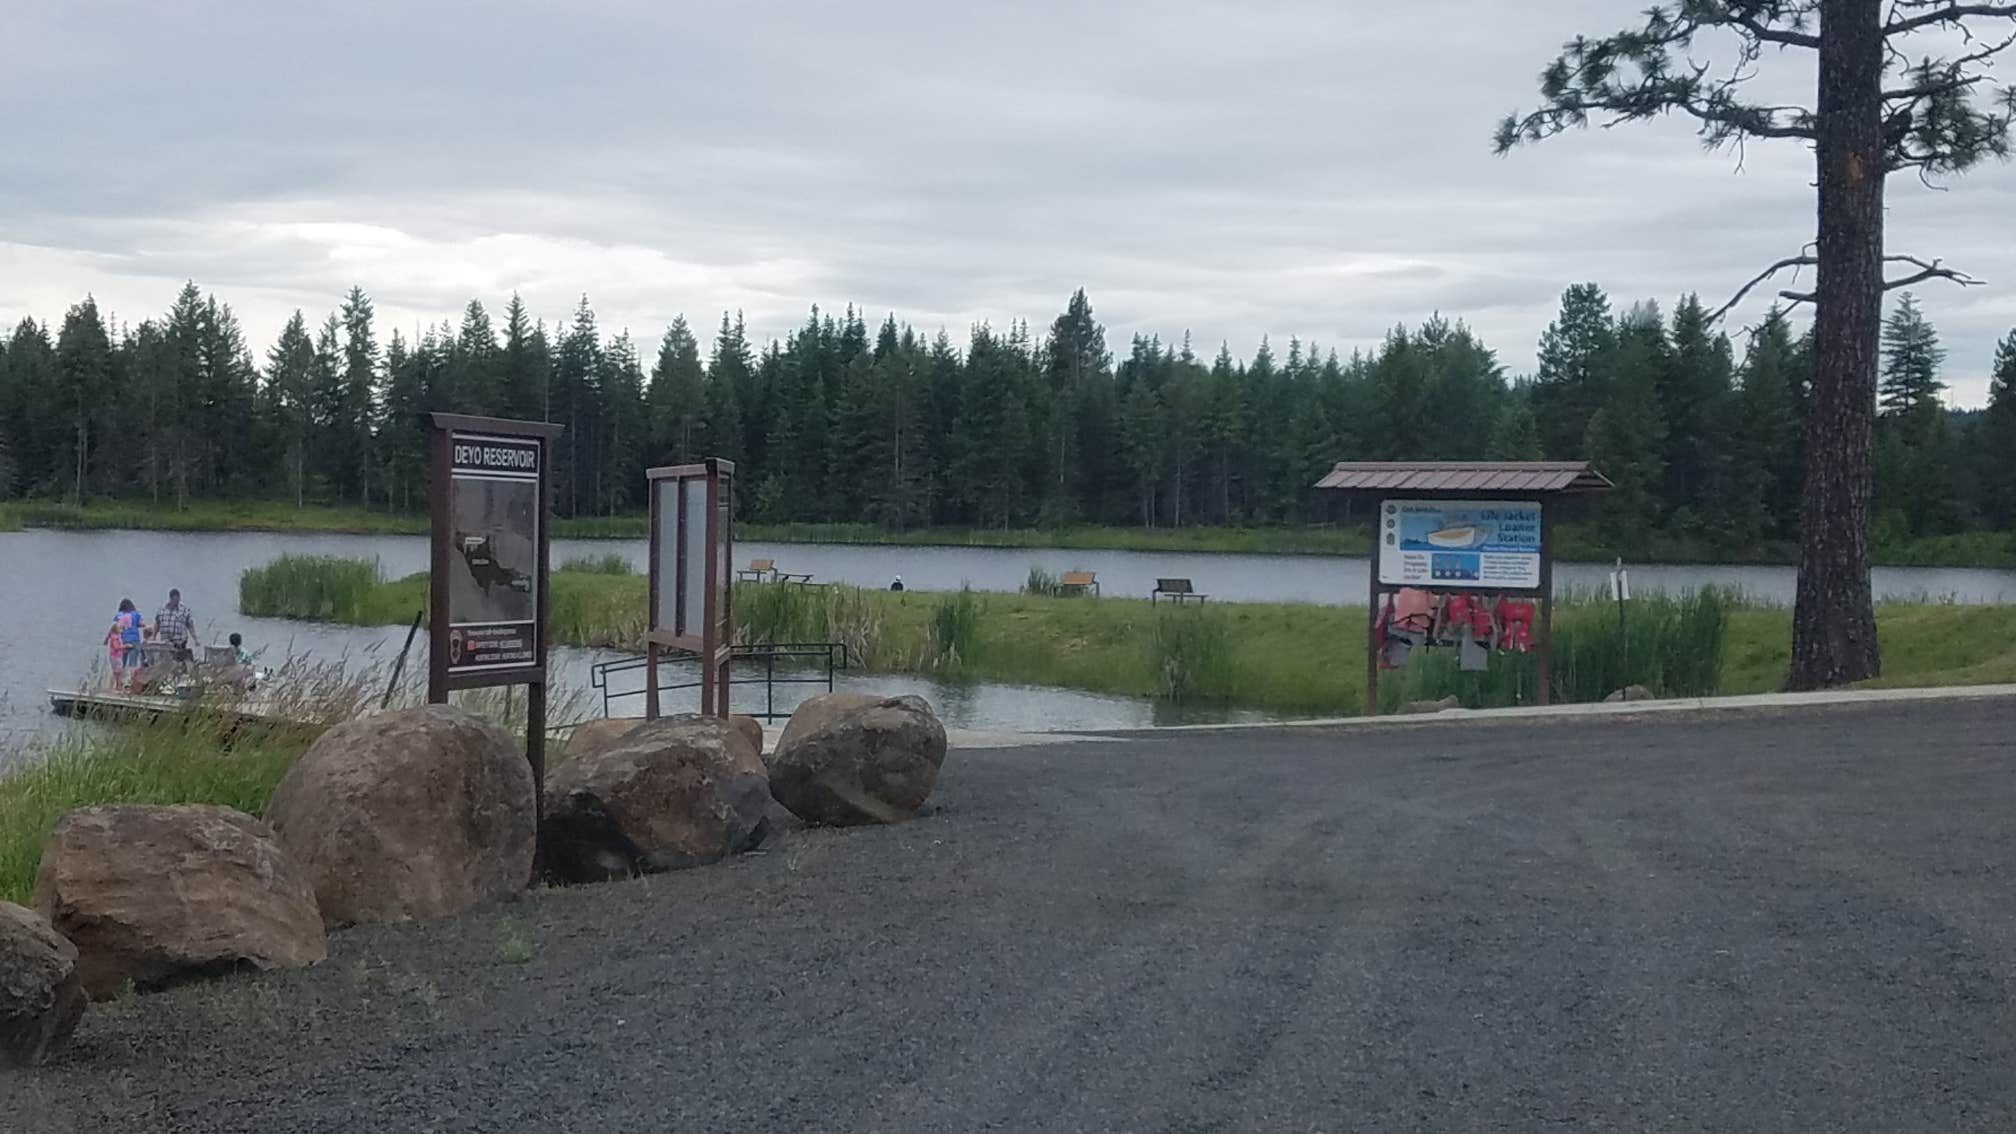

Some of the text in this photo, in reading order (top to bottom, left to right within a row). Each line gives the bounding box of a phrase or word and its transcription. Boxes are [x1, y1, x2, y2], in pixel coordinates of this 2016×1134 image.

[454, 445, 536, 468] DEYO RESERVOIR
[1497, 532, 1536, 543] Station
